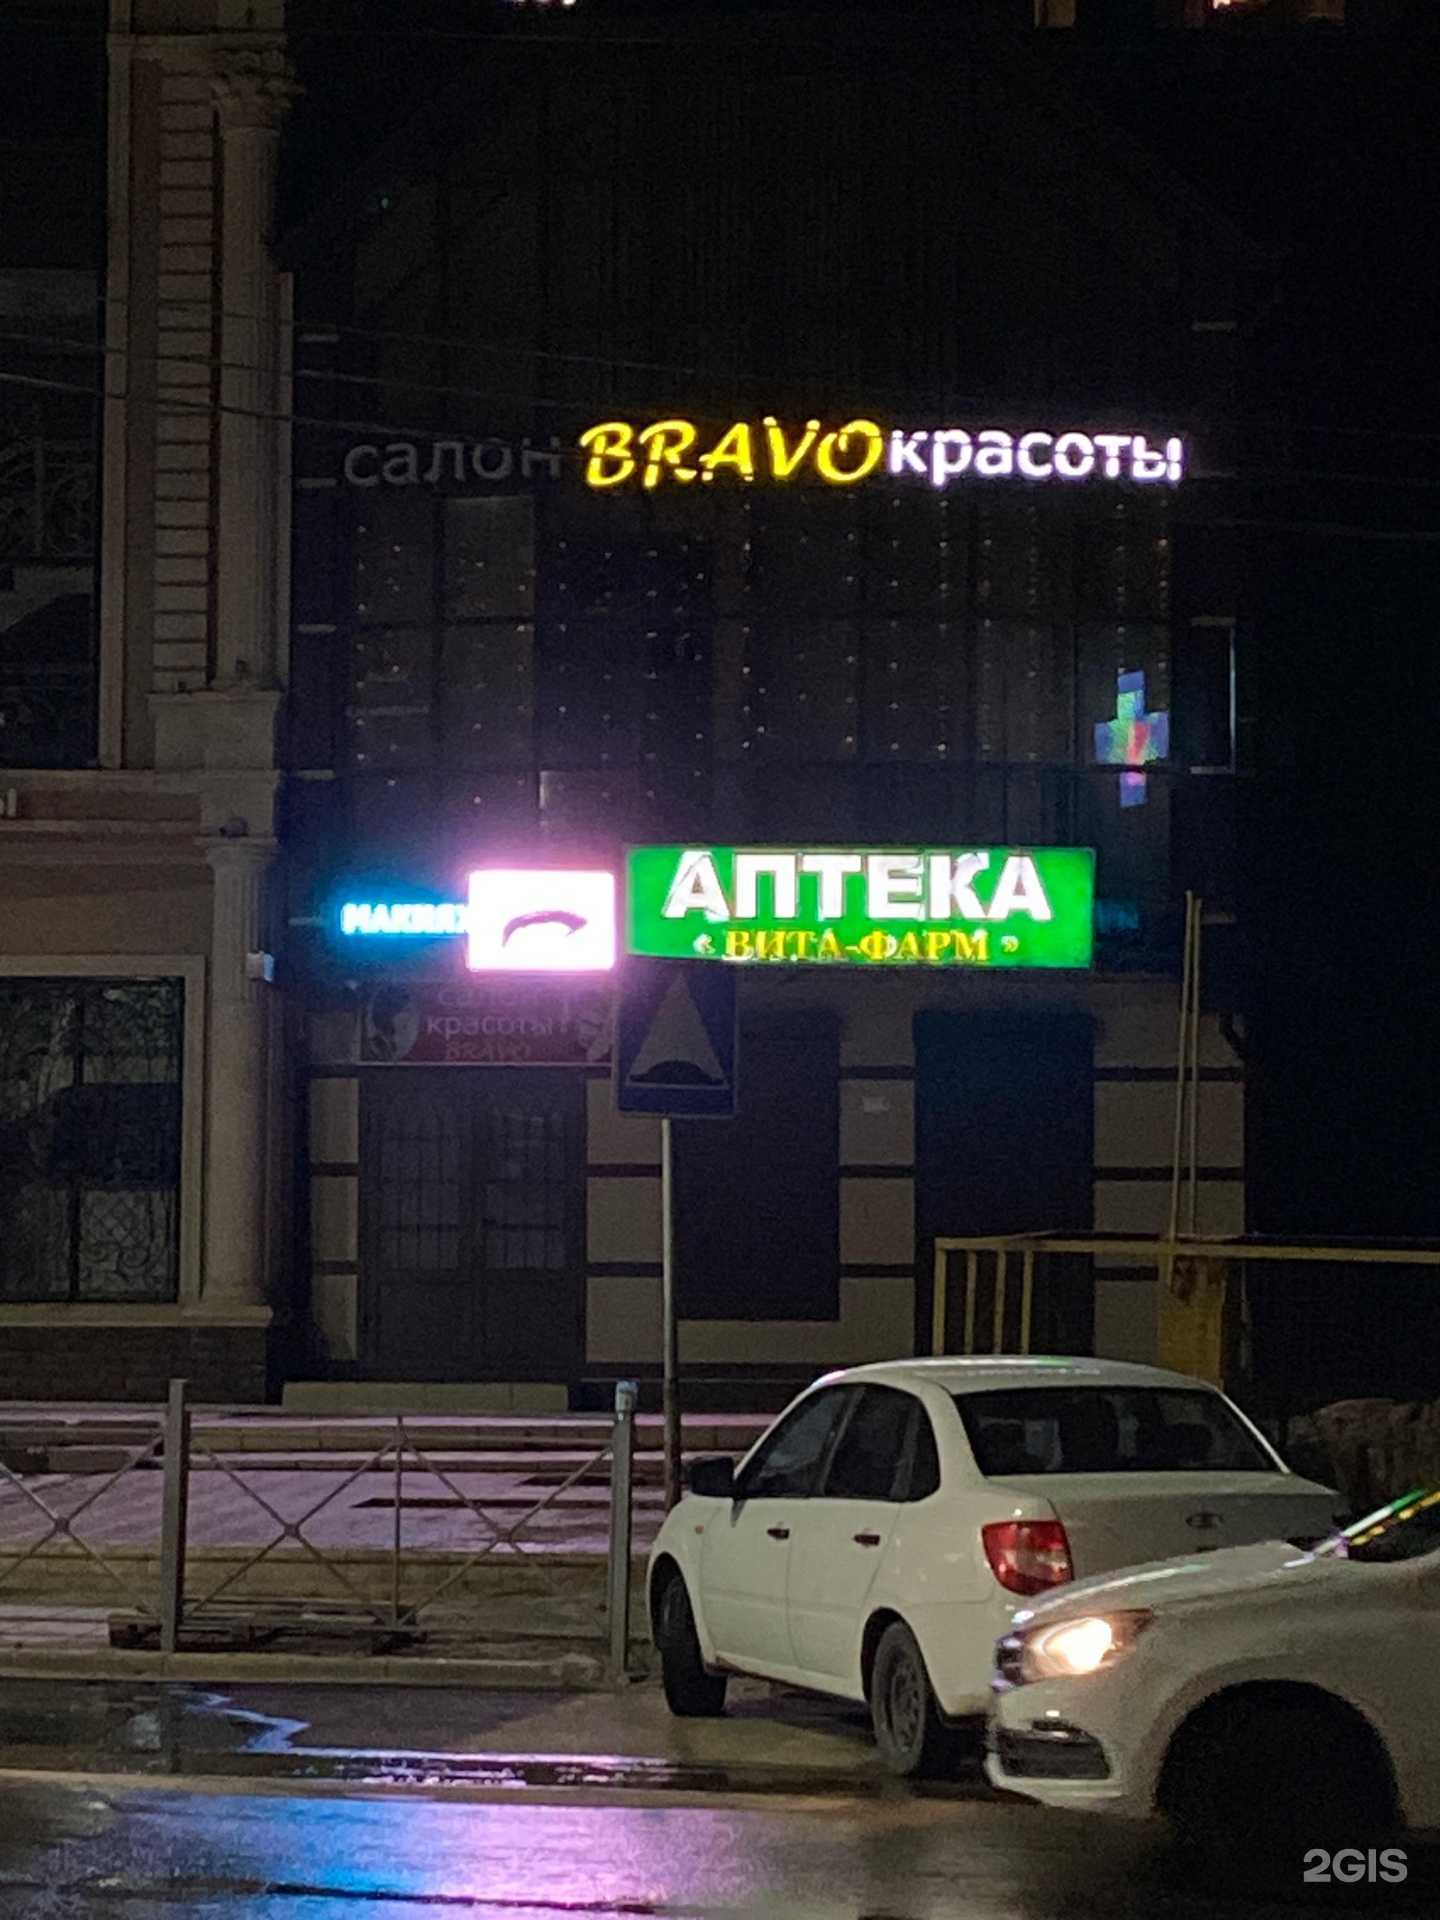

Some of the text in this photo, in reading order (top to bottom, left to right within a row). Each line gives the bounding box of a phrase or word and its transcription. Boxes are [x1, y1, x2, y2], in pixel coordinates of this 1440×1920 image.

[344, 416, 1183, 488] салон BRAVO красоты
[661, 850, 1053, 922] АПТЕКА
